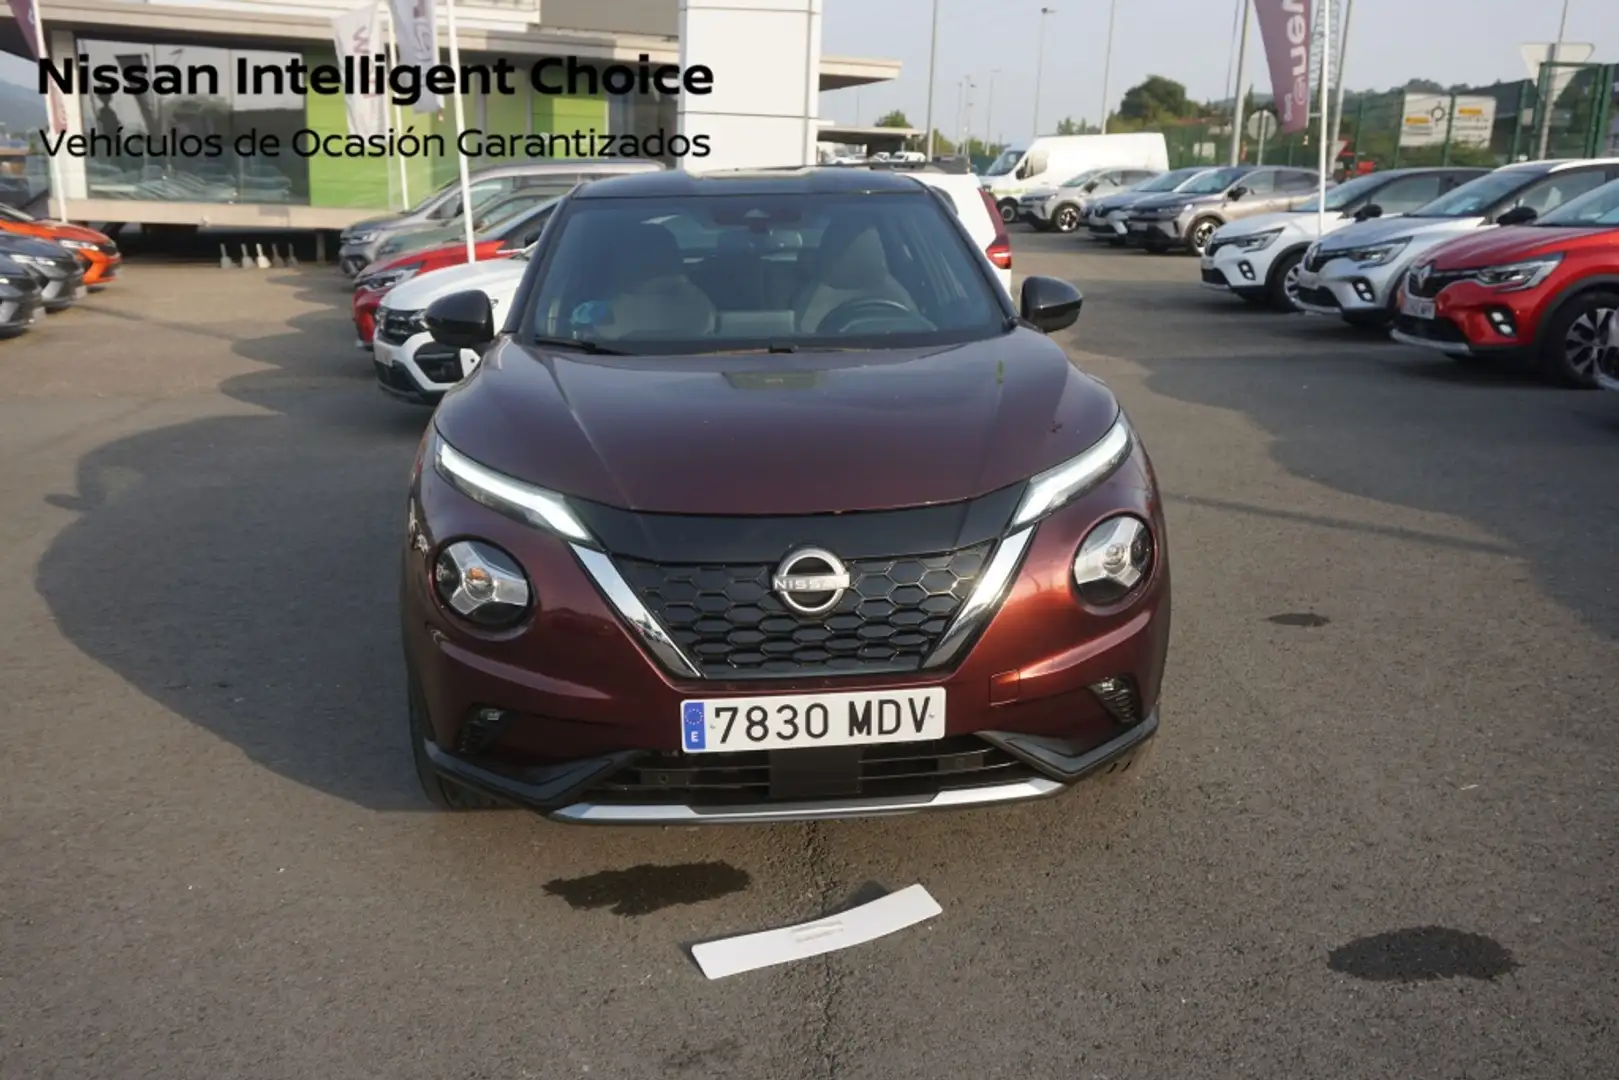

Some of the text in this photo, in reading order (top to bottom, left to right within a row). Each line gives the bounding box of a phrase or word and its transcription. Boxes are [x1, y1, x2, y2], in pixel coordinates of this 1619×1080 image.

[714, 696, 931, 744] 7830 MDV
[691, 731, 699, 742] E
